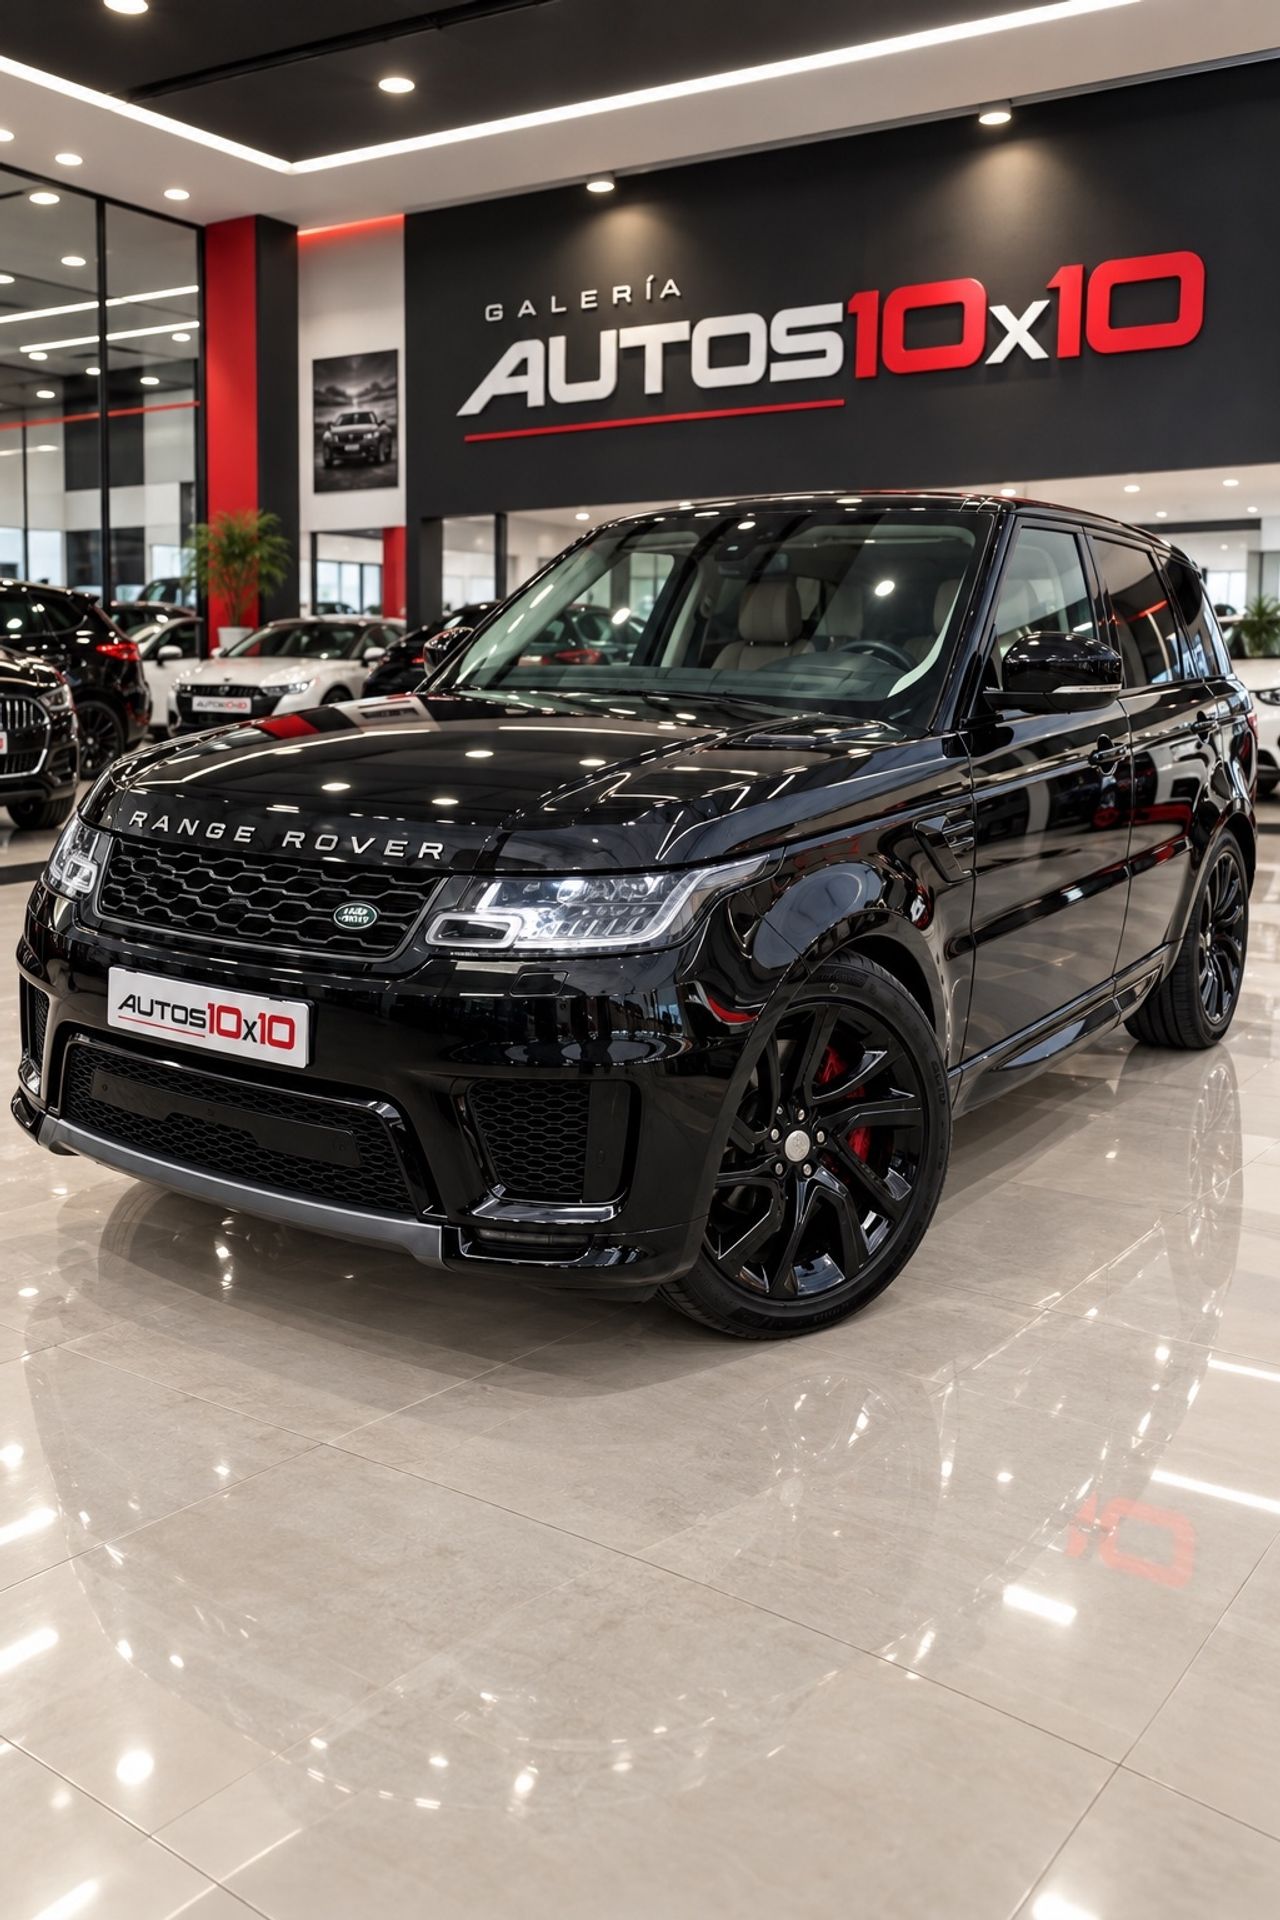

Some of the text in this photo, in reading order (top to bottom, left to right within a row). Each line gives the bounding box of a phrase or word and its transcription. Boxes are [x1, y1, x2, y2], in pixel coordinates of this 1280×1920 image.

[485, 275, 683, 322] GALERÍA
[128, 811, 445, 860] RANGE ROVER
